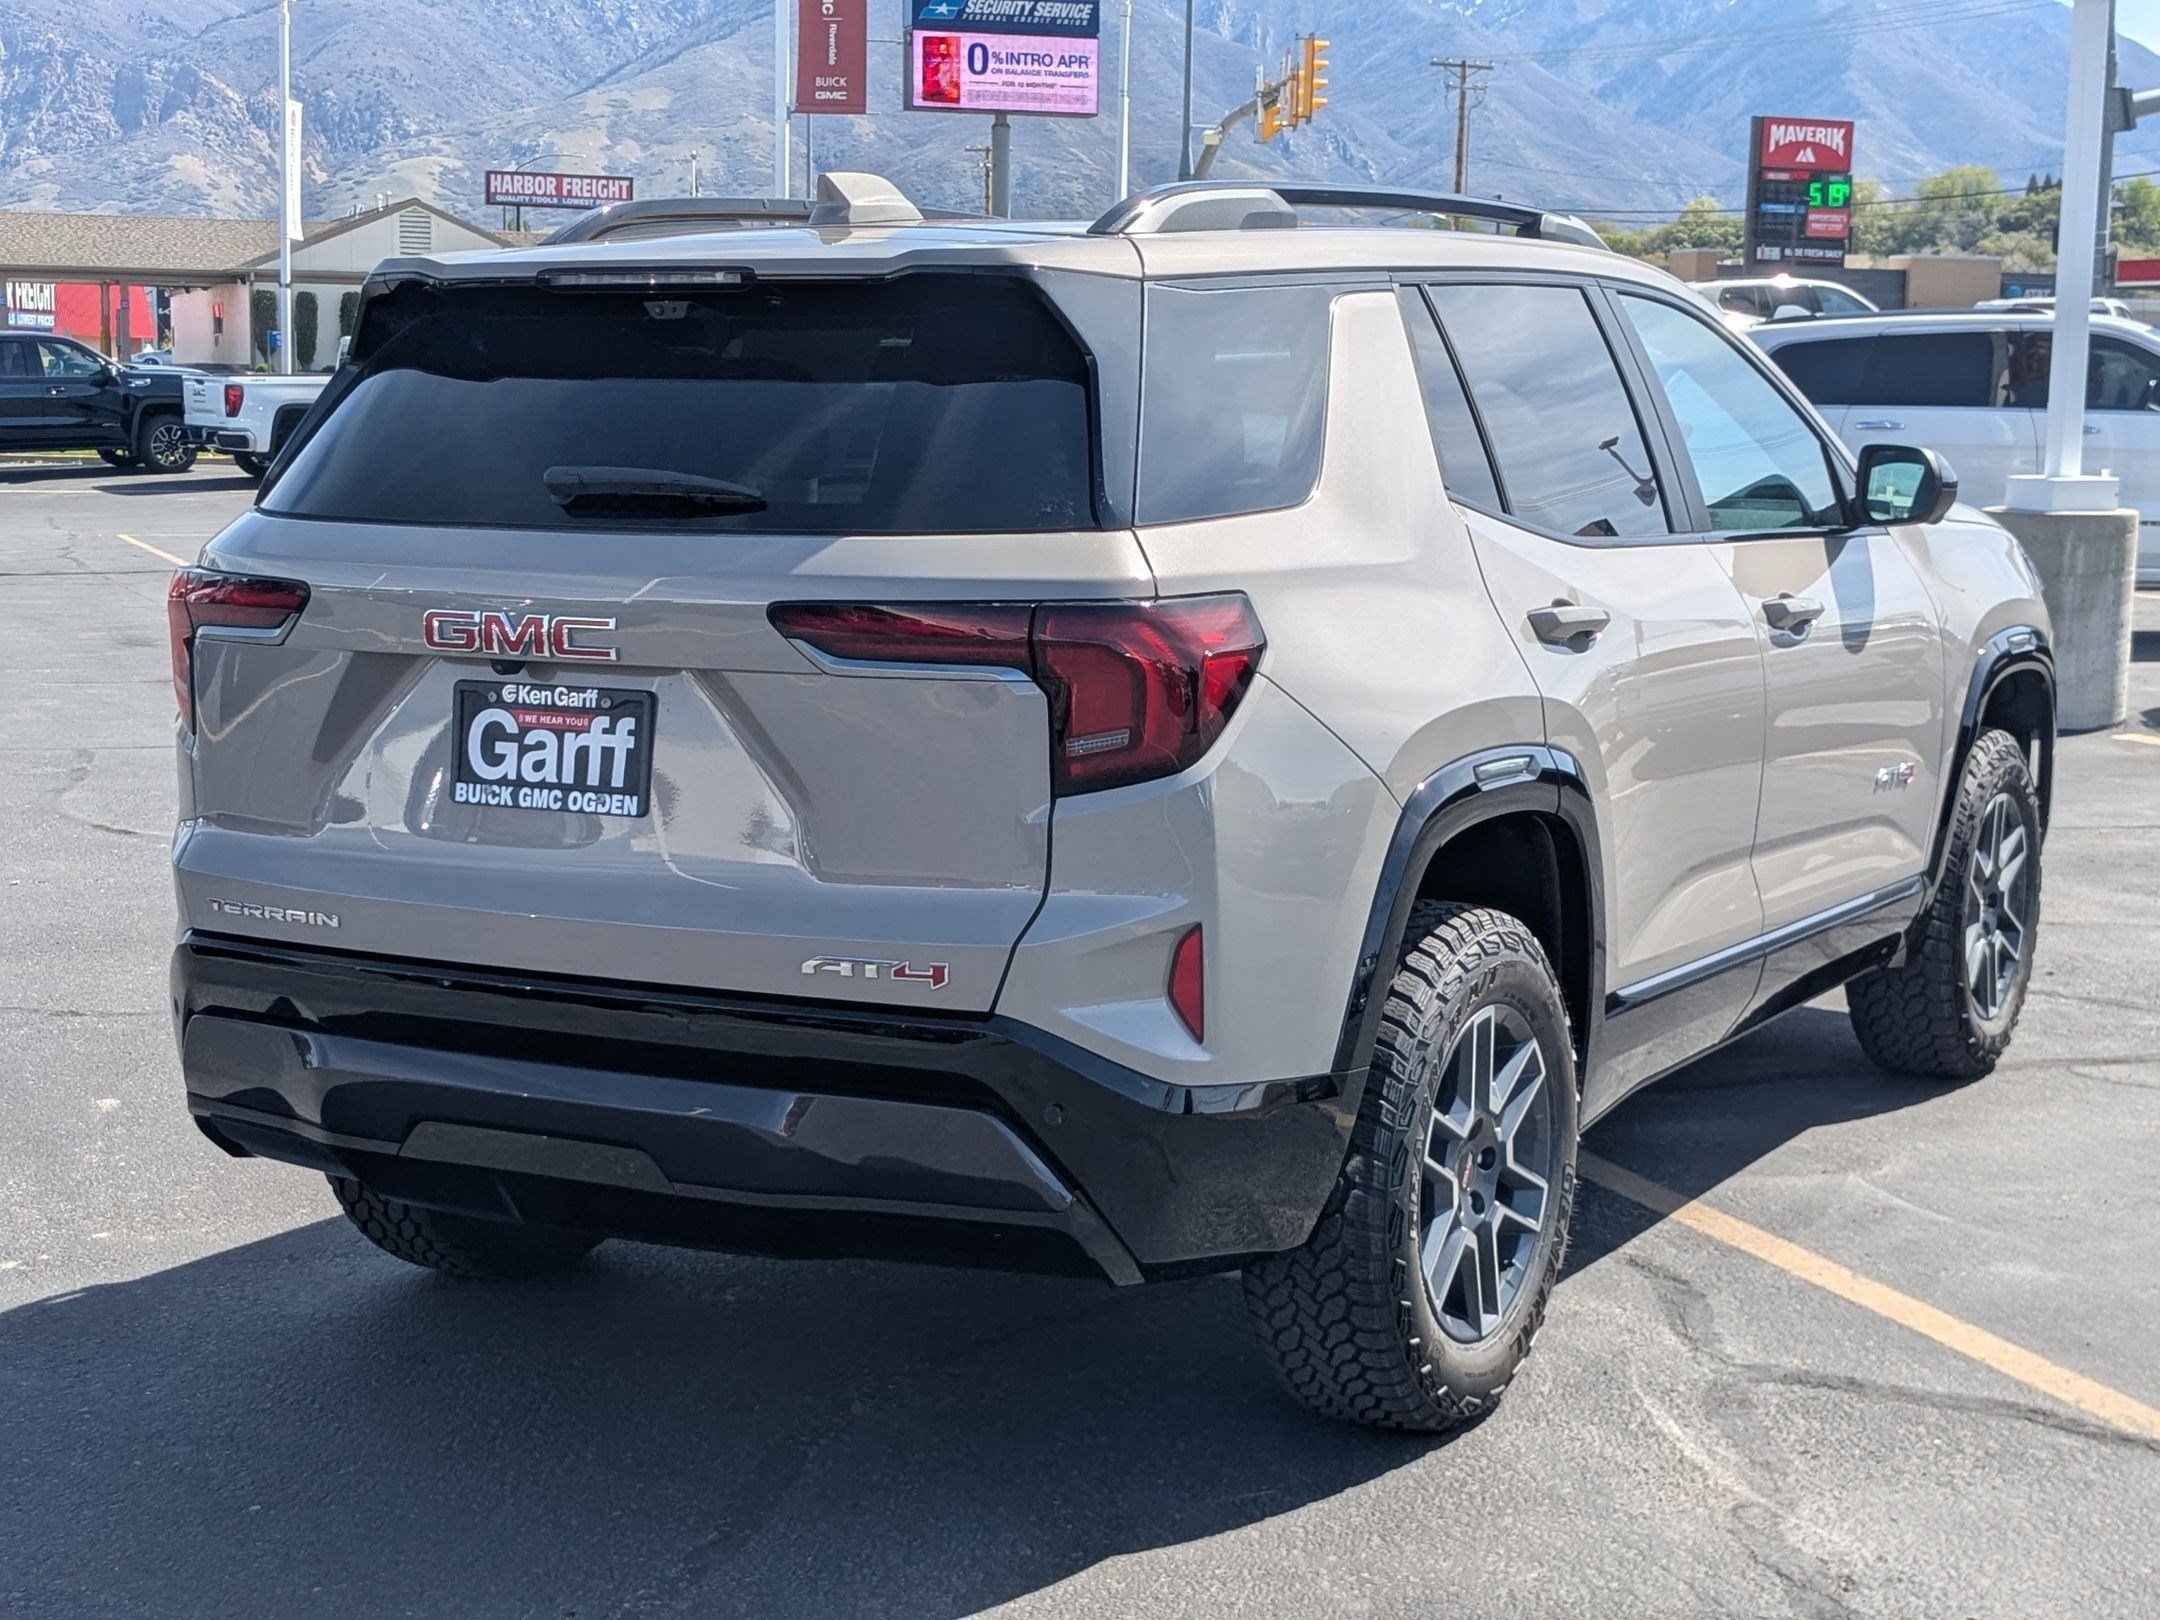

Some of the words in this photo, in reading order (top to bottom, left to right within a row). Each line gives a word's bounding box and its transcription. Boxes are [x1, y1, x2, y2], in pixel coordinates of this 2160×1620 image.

[962, 13, 1007, 22] FEDERAL
[1013, 16, 1051, 24] CREDIT
[1056, 18, 1088, 26] UNION
[965, 0, 1034, 16] SECURITY
[1033, 1, 1093, 19] SERVICE
[822, 0, 834, 15] C
[828, 24, 838, 65] Riverdale
[1005, 52, 1053, 67] INTRO
[816, 77, 847, 87] BUICK
[991, 67, 1003, 75] ON
[1005, 68, 1042, 77] BALANCE
[1044, 70, 1090, 79] TRANSFERS
[815, 91, 848, 100] GMC
[1768, 124, 1846, 157] MAVERIK
[489, 173, 557, 196] HARBOR
[562, 177, 631, 199] FREIGHT
[495, 195, 530, 203] QUALITY
[532, 196, 558, 204] TOOLS
[562, 198, 594, 207] LOWEST
[15, 282, 56, 311] FREIGHT
[423, 609, 619, 661] GMC
[518, 684, 552, 706] Ken
[554, 686, 598, 708] Garff
[524, 714, 537, 723] WE
[539, 715, 563, 725] HEAR
[564, 717, 584, 727] YOU
[467, 708, 636, 788] Garff
[454, 782, 514, 806] BUICK
[518, 787, 563, 810] GMC
[568, 791, 638, 816] OGDEN
[207, 897, 340, 929] TERRAIN
[802, 955, 949, 991] AT4
[1509, 1160, 1575, 1360] GENERAL
